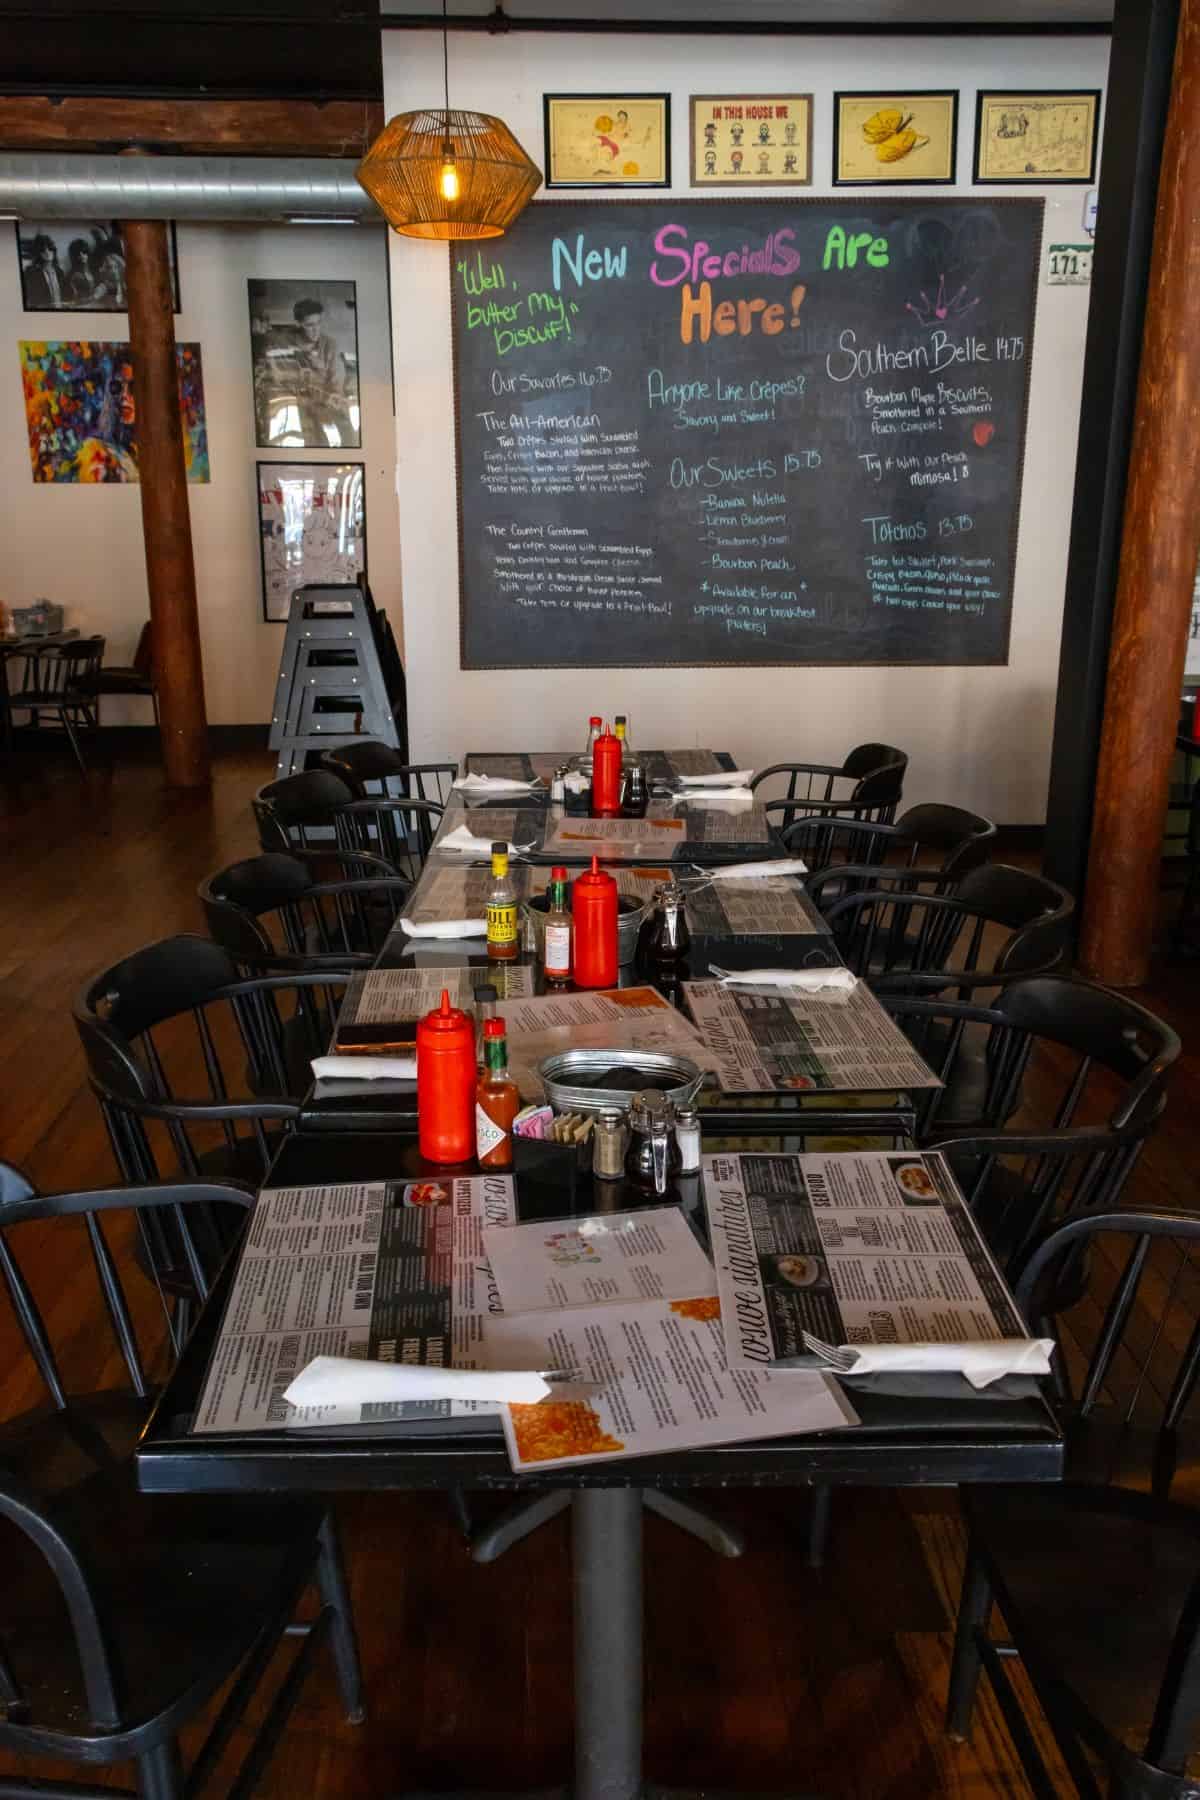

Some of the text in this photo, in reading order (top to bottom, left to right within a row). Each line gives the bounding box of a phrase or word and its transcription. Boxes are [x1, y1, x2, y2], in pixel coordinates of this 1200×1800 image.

[713, 105, 789, 120] IN THIS HOUSE WE
[551, 234, 627, 291] New
[823, 225, 889, 270] Are
[680, 280, 807, 345] Here!
[826, 329, 1024, 382] Southern Belle 14.75
[491, 369, 515, 396] Our
[647, 368, 712, 412] Anyone
[717, 376, 744, 401] Like
[475, 411, 506, 431] The
[670, 448, 822, 488] Our Sweets 15.75
[856, 453, 882, 480] Try
[485, 526, 506, 538] The
[862, 515, 926, 544] Totchos
[457, 1180, 472, 1216] APPETIZERS
[807, 1173, 831, 1208] SEAFOOD
[714, 1189, 760, 1286] signatures
[358, 1273, 374, 1292] YOUR
